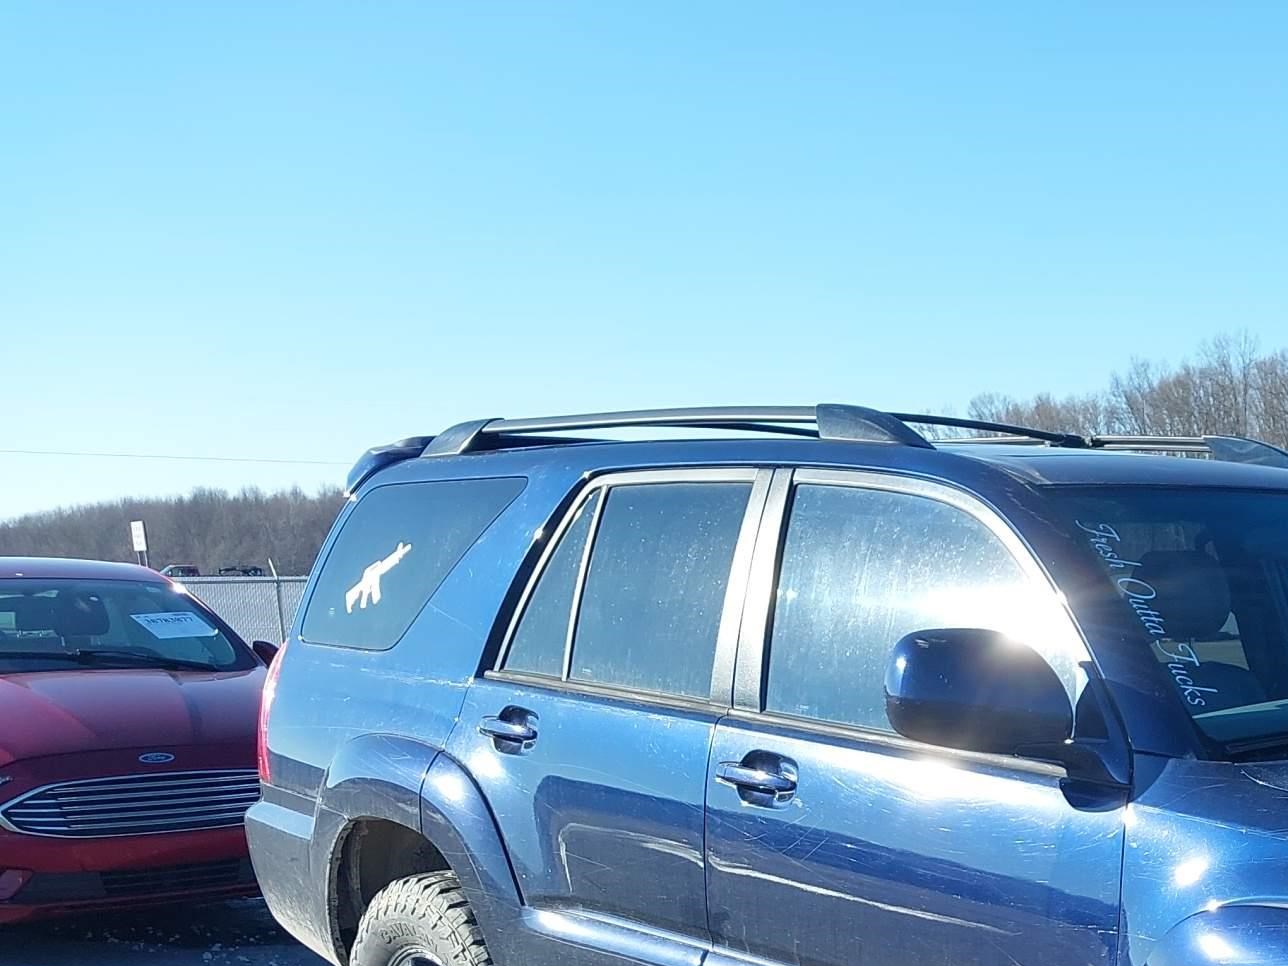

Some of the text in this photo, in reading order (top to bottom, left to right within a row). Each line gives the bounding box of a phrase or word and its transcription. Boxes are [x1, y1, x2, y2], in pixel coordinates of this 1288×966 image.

[1075, 519, 1219, 706] Fresh Outta Fucks
